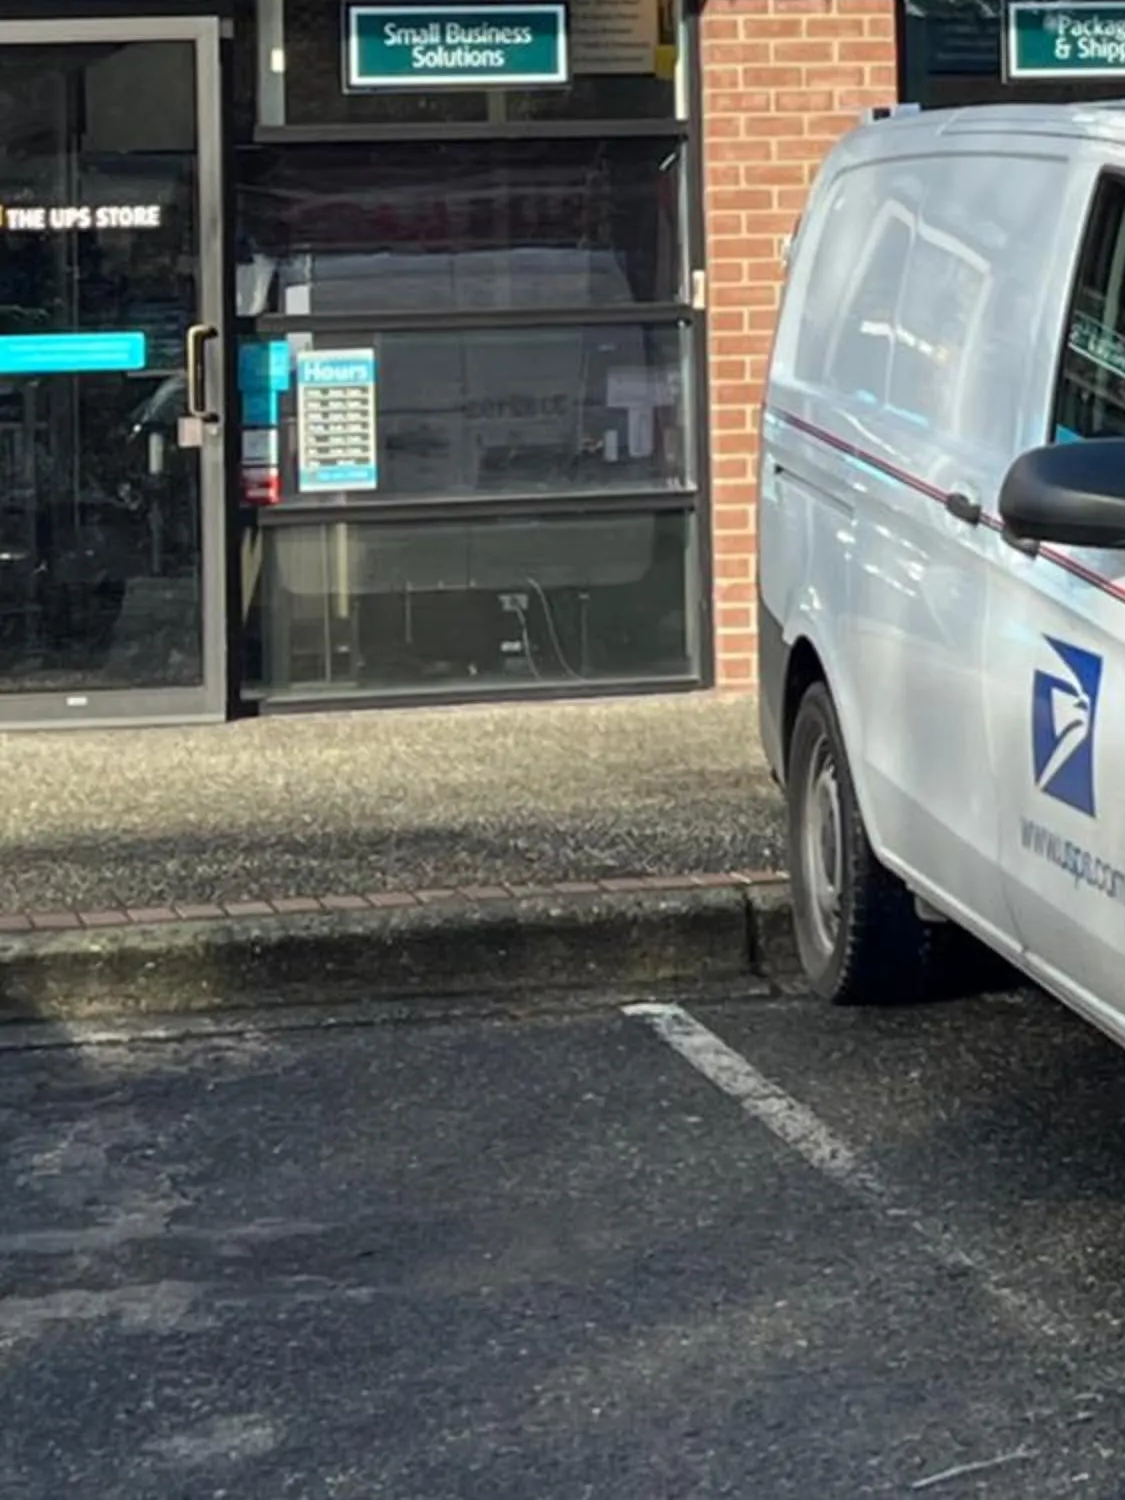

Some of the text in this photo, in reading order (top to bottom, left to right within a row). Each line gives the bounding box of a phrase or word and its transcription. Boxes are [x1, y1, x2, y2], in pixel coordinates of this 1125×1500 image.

[384, 22, 533, 46] Small Business
[411, 46, 505, 68] Solutions
[1054, 36, 1072, 60] &
[6, 204, 161, 230] THE UPS STORE
[304, 360, 368, 381] Hours
